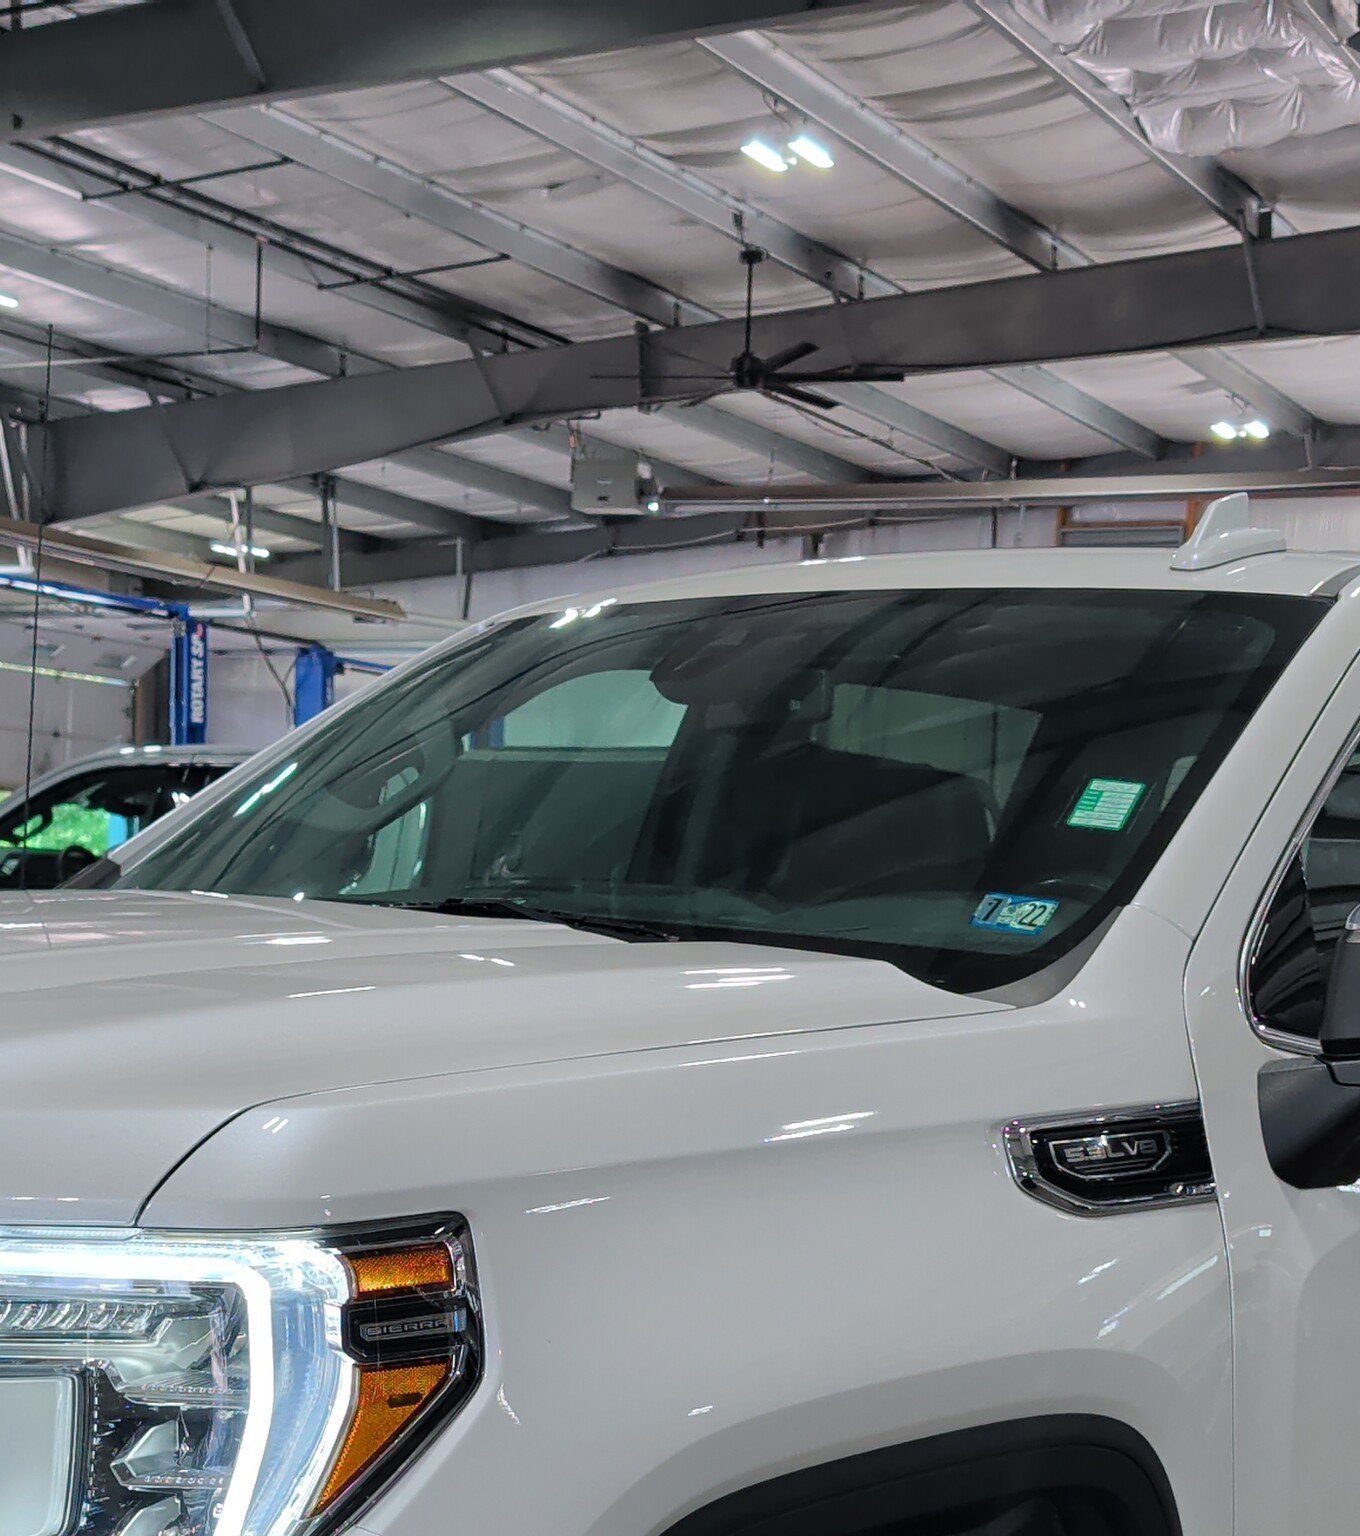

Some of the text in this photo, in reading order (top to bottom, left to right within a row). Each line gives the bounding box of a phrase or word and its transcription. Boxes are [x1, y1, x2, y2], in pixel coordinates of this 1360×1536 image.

[190, 657, 205, 724] ROTARY
[982, 897, 1003, 921] 7
[1018, 902, 1047, 927] 22
[1122, 1138, 1158, 1155] V8
